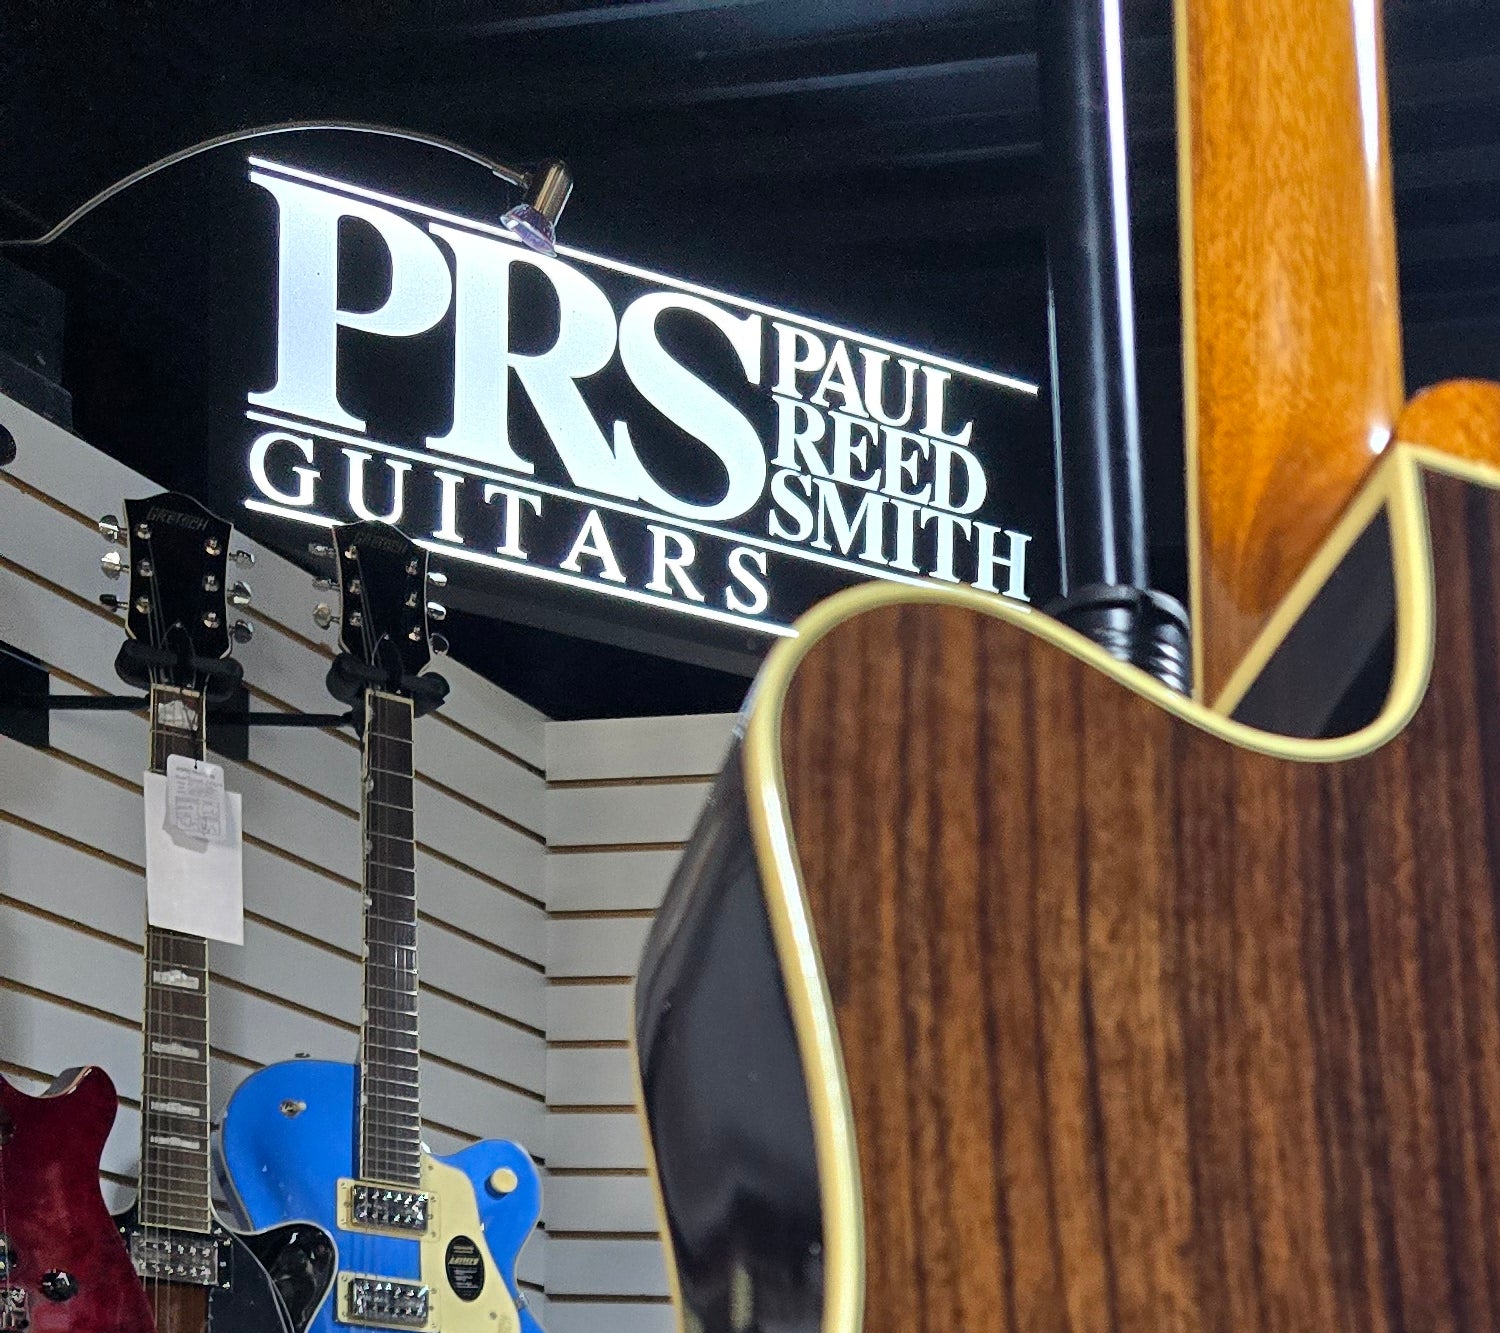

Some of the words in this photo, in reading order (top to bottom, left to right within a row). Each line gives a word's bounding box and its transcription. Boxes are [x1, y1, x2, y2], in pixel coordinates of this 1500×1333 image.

[247, 171, 767, 522] PRS
[771, 321, 973, 446] PAUL
[770, 393, 988, 515] REED
[247, 431, 769, 616] GUITARS
[768, 467, 1033, 603] SMITH
